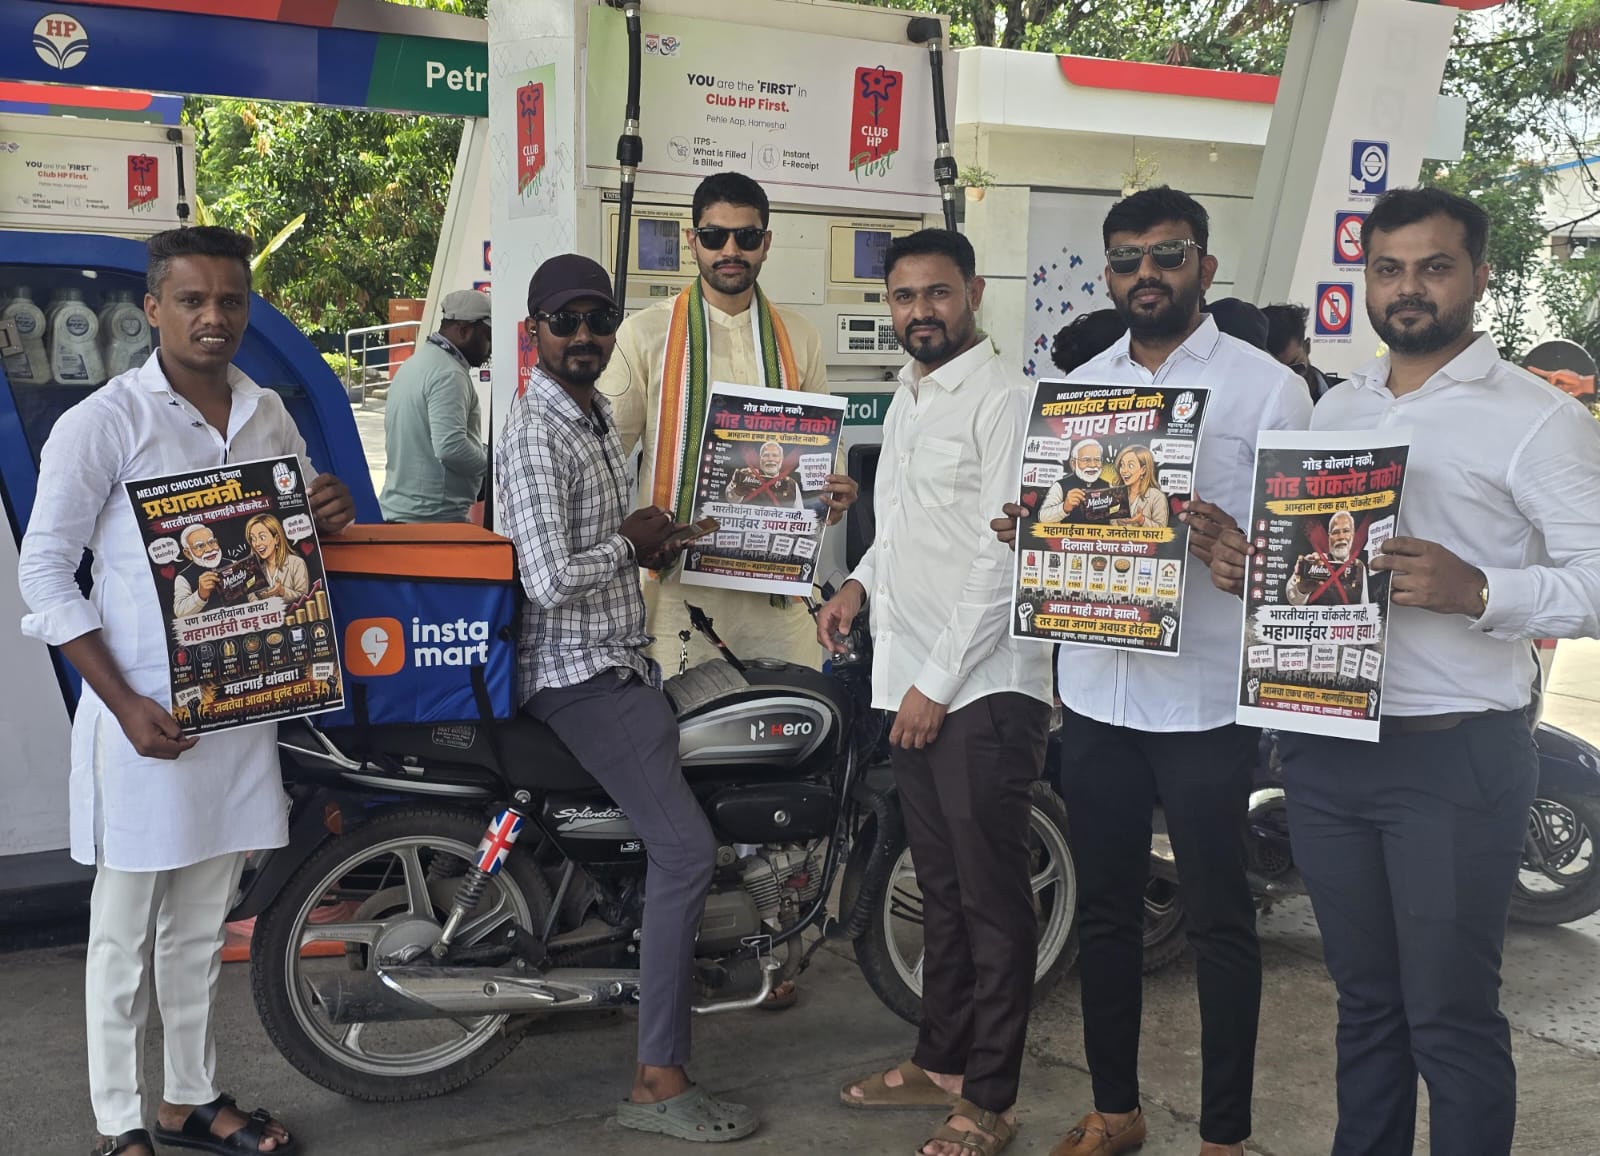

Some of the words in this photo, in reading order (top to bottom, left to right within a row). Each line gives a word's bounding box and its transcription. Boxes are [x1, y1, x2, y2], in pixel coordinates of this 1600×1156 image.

[46, 20, 77, 38] HP
[427, 61, 487, 92] Petr
[687, 73, 715, 87] YOU
[717, 79, 735, 90] are
[737, 81, 755, 91] the
[758, 80, 796, 96] 'FIRST'
[798, 87, 807, 97] in
[706, 94, 736, 107] Club
[739, 97, 755, 109] HP
[759, 99, 789, 113] First.
[707, 115, 728, 124] Pehle
[694, 137, 711, 145] ITPS
[861, 126, 889, 138] CLUB
[523, 144, 539, 156] CLUB
[866, 137, 882, 147] HP
[526, 156, 536, 167] HP
[694, 147, 715, 157] What
[717, 149, 724, 157] is
[725, 150, 746, 160] Filled
[783, 150, 810, 160] Instant
[25, 160, 42, 168] YOU
[693, 158, 700, 166] is
[701, 159, 723, 168] Billed
[783, 160, 819, 171] E-Receipt
[38, 170, 56, 178] Club
[69, 172, 89, 181] First.
[1057, 391, 1083, 400] MELODY
[1084, 389, 1122, 399] CHOCOLATE
[744, 404, 757, 412] गोड
[760, 404, 783, 414] बोलणं
[785, 406, 805, 416] नको,
[1041, 398, 1106, 417] महागाईवर
[1108, 393, 1136, 411] चर्चा
[1136, 391, 1165, 410] नको,
[715, 410, 741, 429] गोड
[744, 410, 797, 432] चॉकलेट
[799, 416, 837, 435] नको!
[1061, 414, 1113, 439] उपाय
[1115, 409, 1156, 436] हवा!
[1302, 457, 1322, 471] गोड
[1325, 454, 1353, 469] बोलणं
[1355, 452, 1375, 467] नको,
[137, 484, 169, 500] MELODY
[170, 474, 219, 493] CHOCOLATE
[1265, 472, 1301, 498] गोड
[1305, 468, 1368, 497] चॉकलेट
[1370, 461, 1402, 489] नको!
[142, 479, 262, 520] प्रधानमंत्री...
[1087, 495, 1113, 508] Melody
[1284, 502, 1315, 512] आम्हाला
[1317, 502, 1333, 512] हक्क
[1335, 500, 1349, 511] हवा,
[1350, 496, 1372, 507] चॉकलेट
[1372, 495, 1386, 504] नको!
[161, 514, 203, 530] भारतीयांना
[204, 505, 235, 520] महागाईचे
[713, 505, 752, 516] भारतीयांना
[754, 506, 784, 518] चॉकलेट
[785, 511, 803, 520] नाही,
[762, 520, 787, 531] उपाय
[789, 522, 812, 533] हवा!
[1043, 525, 1085, 537] महागाईचा
[1087, 529, 1104, 539] मार,
[1106, 527, 1140, 539] जनतेला
[1142, 530, 1164, 540] फार!
[1061, 539, 1094, 552] दिलासा
[1096, 542, 1118, 553] देणार
[1121, 542, 1149, 554] कोण?
[223, 569, 247, 589] Melody
[184, 617, 199, 627] पण
[202, 607, 245, 624] भारतीयांना
[247, 602, 269, 614] काय?
[1049, 603, 1070, 614] आता
[1072, 603, 1092, 617] नाही
[1093, 605, 1112, 618] जागे
[1114, 609, 1142, 622] झालो,
[1270, 607, 1319, 621] भारतीयांना
[1321, 606, 1351, 621] चॉकलेट
[1353, 607, 1369, 622] नाही,
[183, 619, 239, 642] महागाईची
[241, 617, 261, 634] कडू
[263, 613, 282, 625] चव!
[412, 617, 489, 644] insta
[1040, 616, 1051, 626] तर
[1054, 617, 1070, 628] उद्या
[1072, 619, 1097, 631] जगणं
[1129, 623, 1156, 636] होईल!
[1262, 621, 1328, 643] महागाईवर
[1330, 625, 1355, 640] उपाय
[1357, 624, 1376, 641] हवा!
[414, 640, 489, 668] mart
[224, 674, 263, 696] महागाई
[215, 697, 244, 714] जनतेचा
[245, 691, 272, 706] आवाज
[274, 686, 292, 702] बुलंद
[293, 682, 311, 695] करा!
[771, 720, 812, 738] Hero
